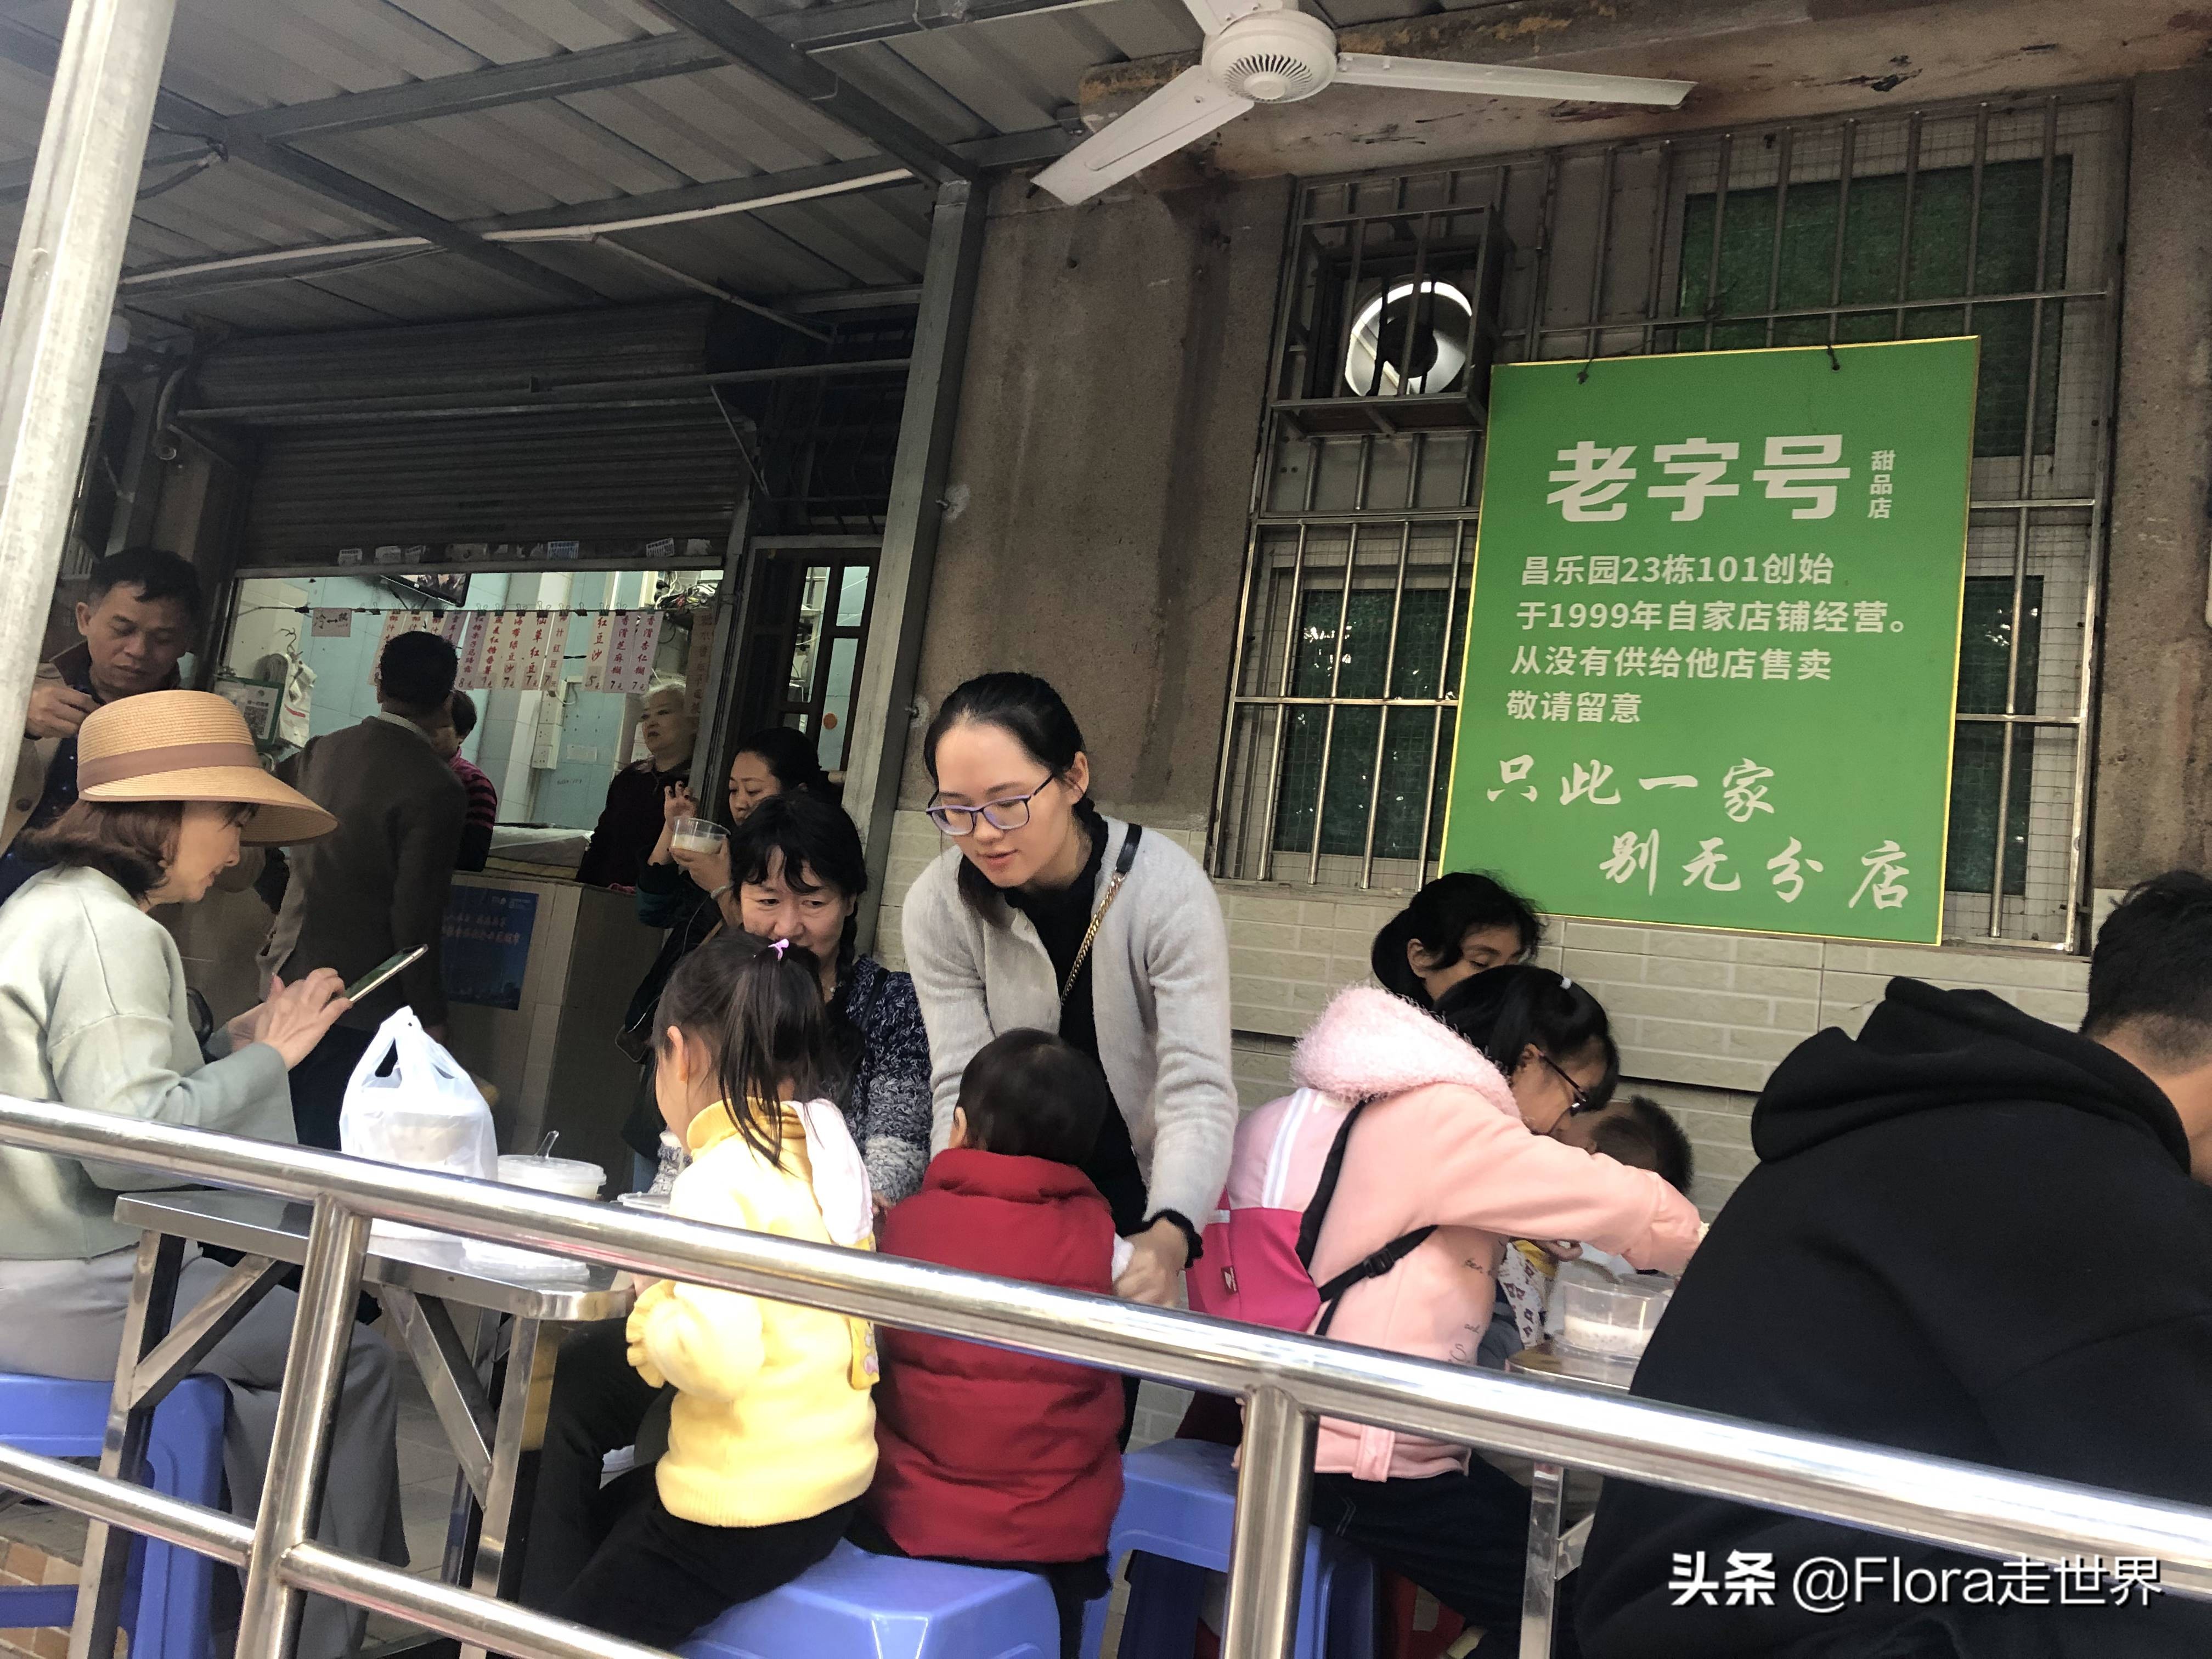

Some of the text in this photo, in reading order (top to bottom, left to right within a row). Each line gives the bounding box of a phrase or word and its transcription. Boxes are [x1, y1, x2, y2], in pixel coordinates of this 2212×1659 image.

[1547, 434, 1850, 522] 老字号
[1868, 450, 1896, 520] 甜品店
[1521, 554, 1834, 585] 昌乐园23栋101创始
[526, 617, 546, 674] 仙草红豆
[591, 617, 607, 662] 红豆沙
[1516, 600, 1906, 634] 于1999年自家店铺经营。
[634, 616, 656, 676] 香滑杏仁糊
[1510, 646, 1832, 681] 从没有供给他店售卖
[1506, 690, 1643, 724] 敬请留意
[1487, 755, 1776, 822] 只此一家
[1599, 829, 1911, 910] 别无分店
